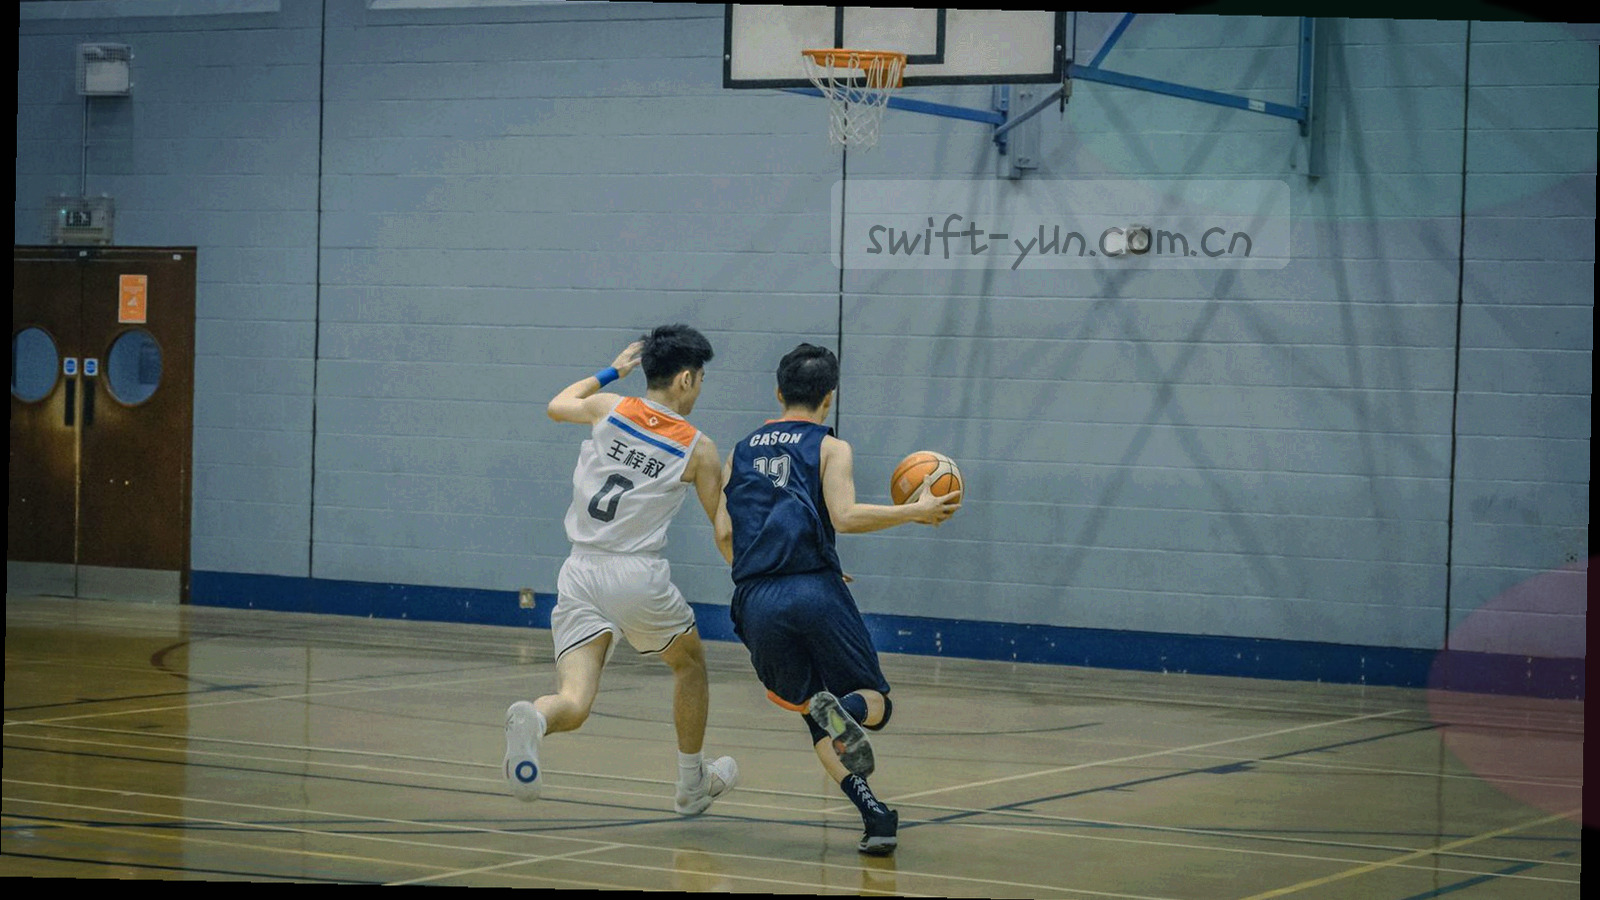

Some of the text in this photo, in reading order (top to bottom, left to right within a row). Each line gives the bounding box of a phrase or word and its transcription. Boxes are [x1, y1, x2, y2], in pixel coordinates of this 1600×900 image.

[749, 430, 802, 447] CASON
[606, 439, 666, 479] 王梓叙
[587, 473, 634, 522] 0
